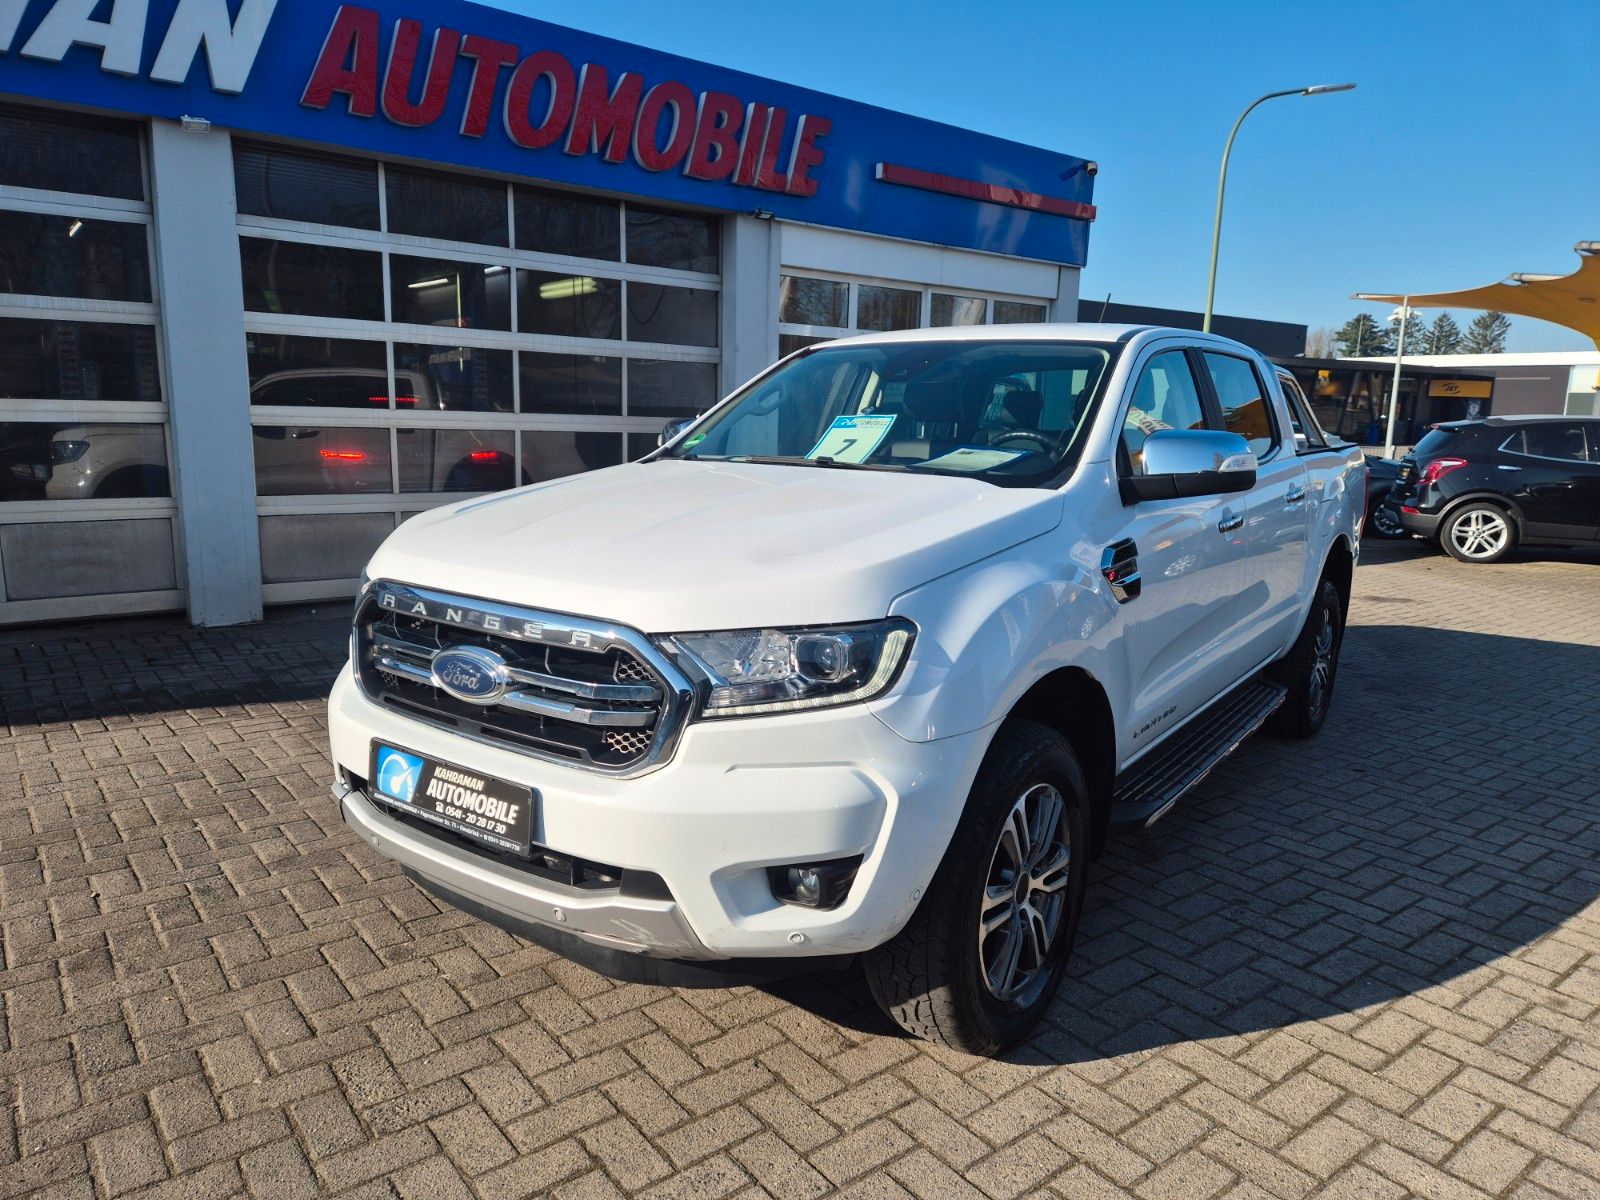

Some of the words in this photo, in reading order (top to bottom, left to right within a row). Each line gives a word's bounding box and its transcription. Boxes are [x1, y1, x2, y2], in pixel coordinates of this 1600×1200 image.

[0, 0, 279, 94] AN
[299, 5, 832, 197] AUTOMOBILE
[833, 438, 857, 456] 7
[383, 593, 592, 648] RANGER
[442, 662, 482, 690] Ford
[433, 766, 485, 791] KAHRAMAN
[426, 778, 519, 825] AUTOMOBILE
[445, 805, 462, 819] 0541
[466, 812, 477, 824] 20
[476, 816, 487, 828] 28
[487, 820, 495, 831] 17
[494, 823, 506, 834] 30
